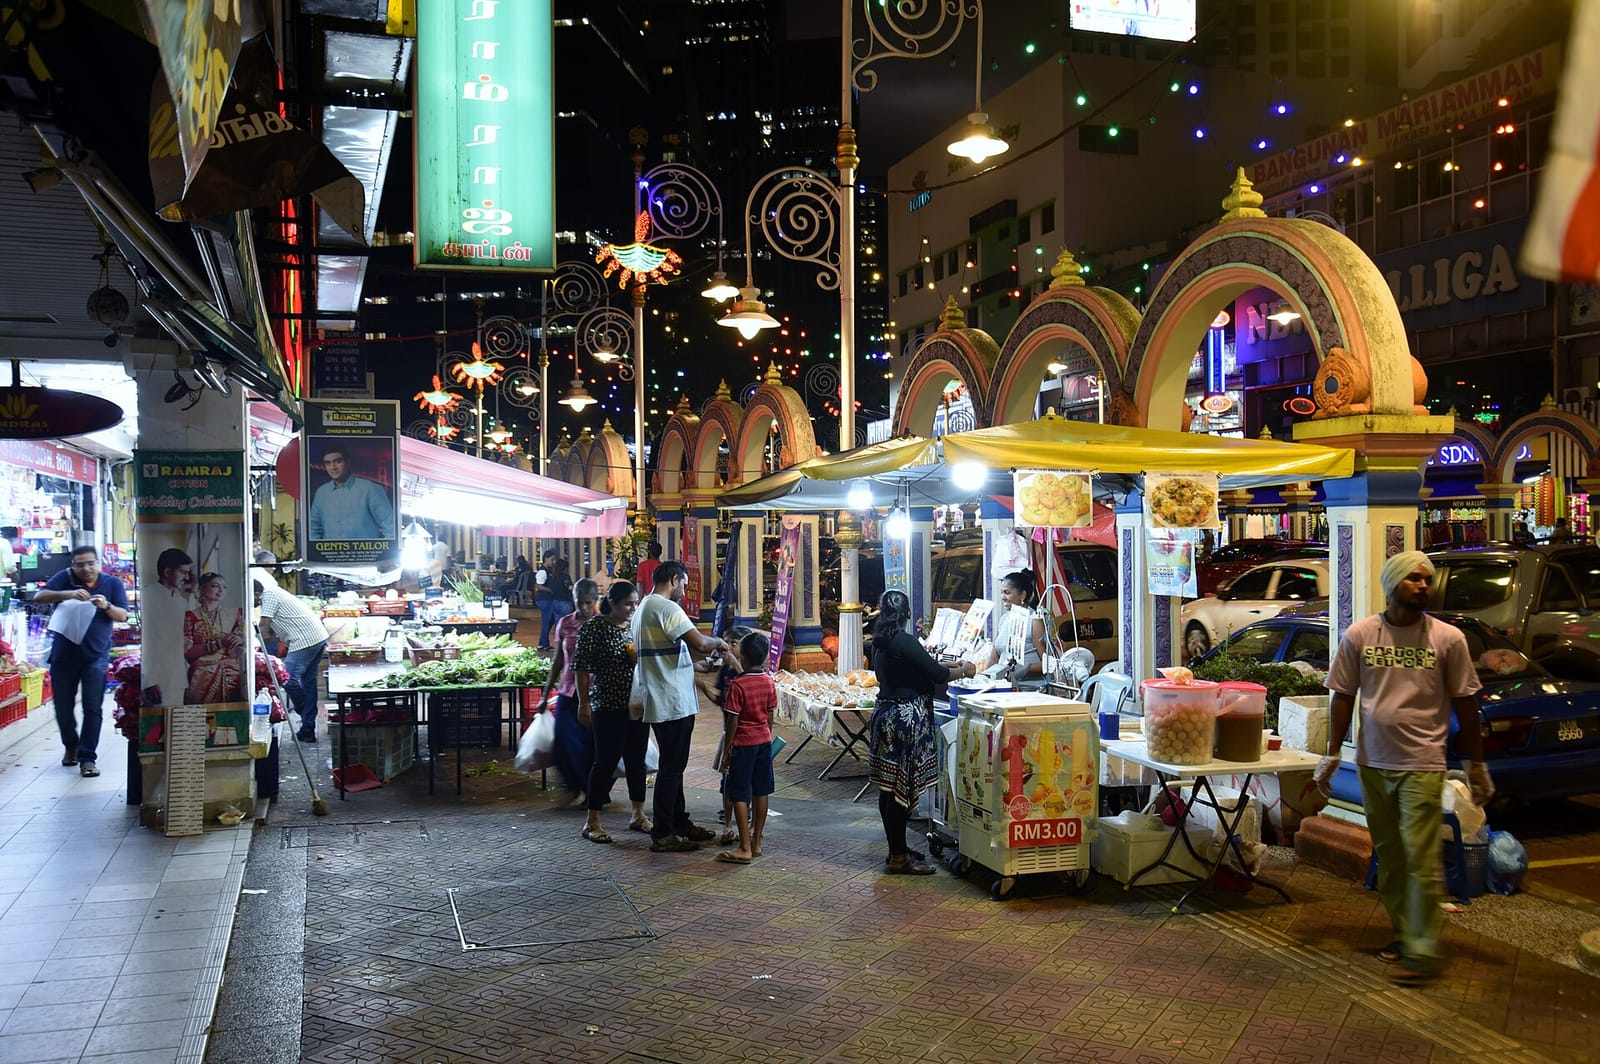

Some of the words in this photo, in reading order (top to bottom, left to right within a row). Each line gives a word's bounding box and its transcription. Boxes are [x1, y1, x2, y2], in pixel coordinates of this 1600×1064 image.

[1254, 123, 1369, 184] BANGUNAN
[1376, 52, 1543, 140] MARIAMMAN
[909, 190, 932, 213] LOTUS
[332, 412, 374, 422] RAMRAJ
[1440, 445, 1480, 464] SDN.
[55, 452, 75, 474] BHD.
[160, 465, 233, 477] RAMRAJ
[168, 479, 209, 489] COTTON
[139, 494, 187, 510] Wedding
[188, 494, 241, 508] Collection
[315, 542, 350, 551] GENTS
[352, 541, 390, 550] TAILOR
[1364, 646, 1437, 659] CARTOON
[1364, 656, 1437, 670] NETWORK
[1558, 728, 1583, 742] 5560
[1014, 821, 1077, 841] RM3.00
